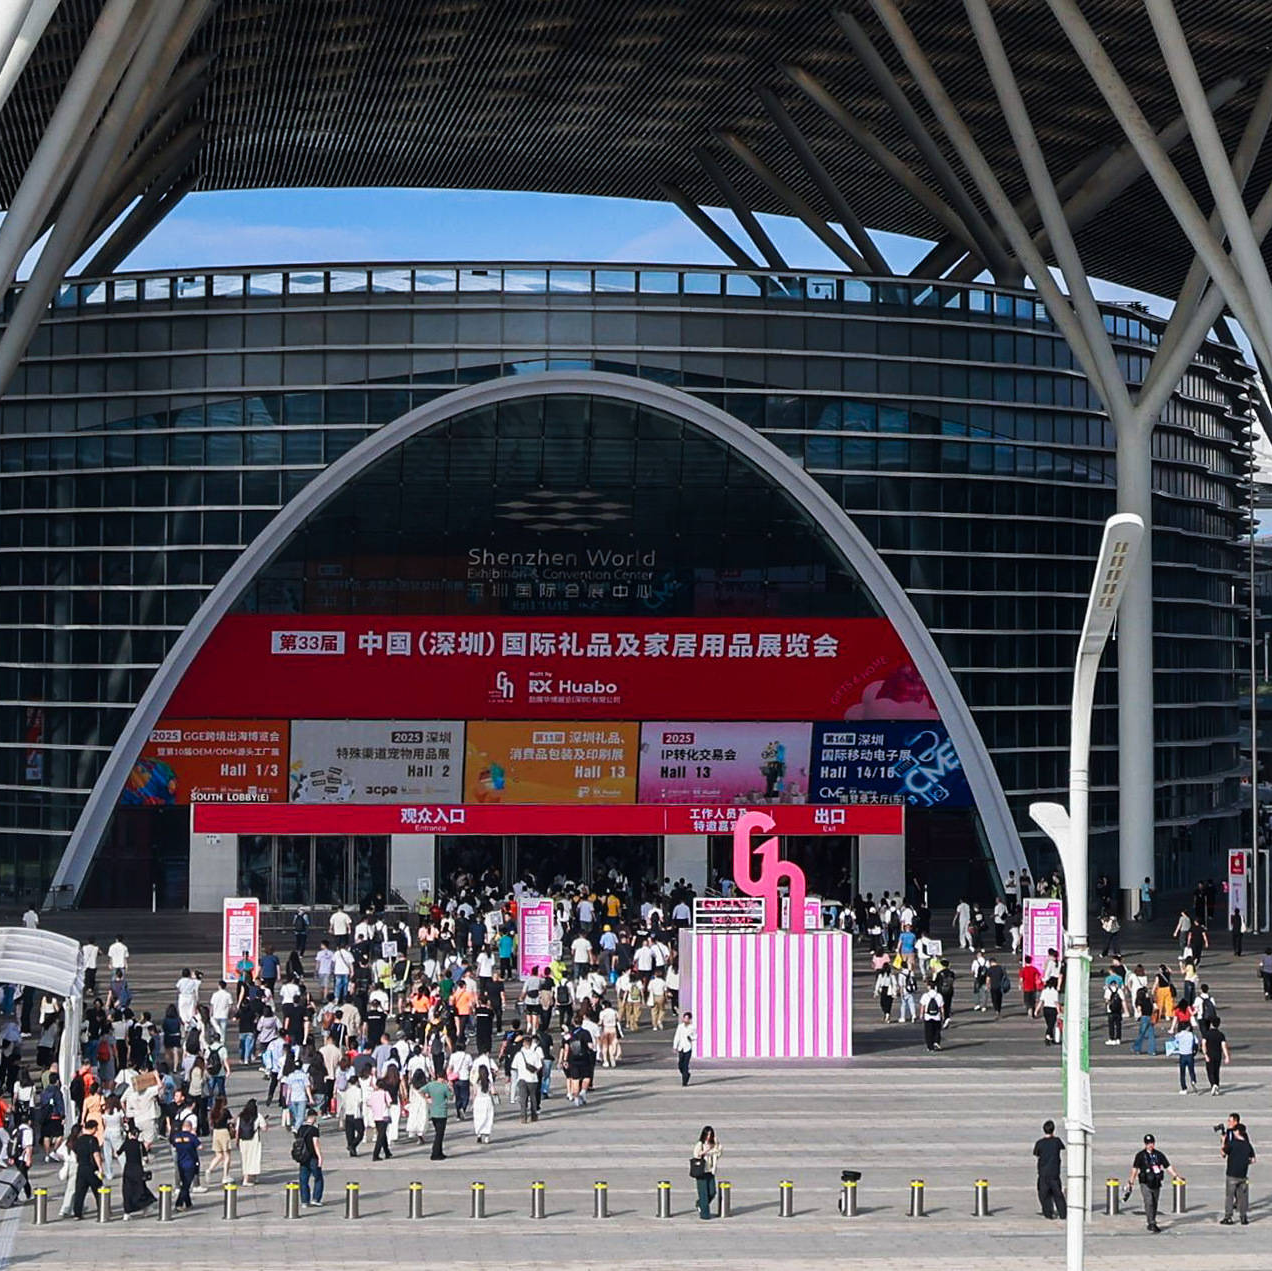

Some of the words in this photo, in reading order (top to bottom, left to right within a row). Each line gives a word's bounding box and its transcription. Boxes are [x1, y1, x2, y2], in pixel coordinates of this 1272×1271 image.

[468, 548, 578, 566] Shenzhen
[586, 548, 656, 566] World
[542, 568, 611, 579] Convention
[613, 568, 653, 579] Center
[279, 634, 338, 652] 第33届
[529, 680, 552, 693] RX
[559, 680, 618, 694] Huabo
[152, 731, 178, 741] 2025
[393, 732, 421, 742] 2025
[425, 731, 452, 744] 深圳
[665, 734, 692, 743] 2025
[857, 733, 884, 746] 深圳
[336, 747, 450, 760] 特殊渠道宠物用品展
[509, 747, 625, 761] 消费品包装及印刷展
[661, 748, 737, 761] IP转化交易会
[821, 749, 911, 762] 国际移动电子展
[220, 763, 246, 776] Hall
[256, 763, 279, 776] 1/3
[407, 764, 433, 777] Hall
[442, 765, 450, 777] 2
[574, 765, 601, 778] Hall
[610, 765, 626, 778] 13
[660, 766, 686, 778] Hall
[696, 766, 711, 778] 13
[820, 766, 847, 778] Hall
[191, 792, 223, 802] SOUTH
[401, 807, 465, 823] 观众入口
[814, 808, 845, 824] 出口
